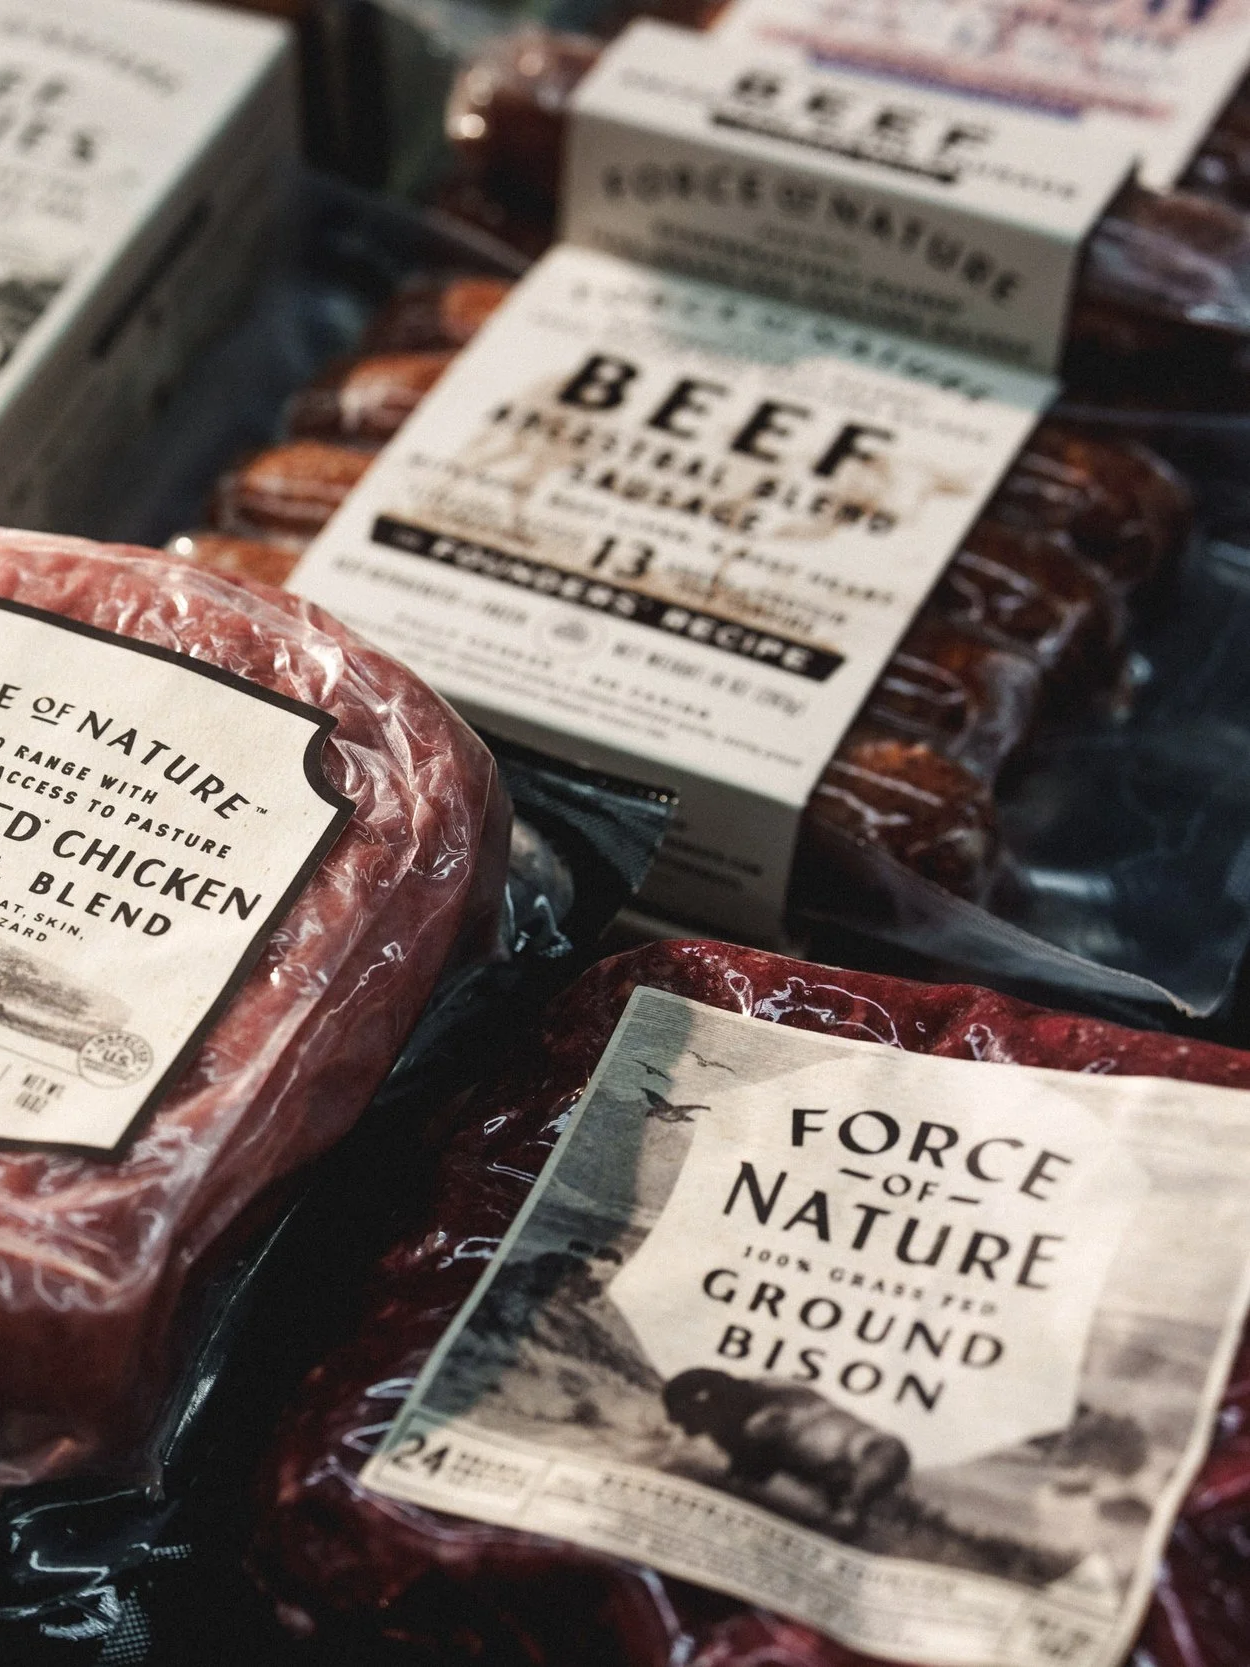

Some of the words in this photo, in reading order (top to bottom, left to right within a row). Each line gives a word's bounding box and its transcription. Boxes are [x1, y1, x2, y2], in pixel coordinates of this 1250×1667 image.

[730, 67, 993, 155] BEEF
[557, 351, 897, 478] BEEF
[590, 533, 655, 580] 13
[661, 605, 813, 673] RECIPE
[31, 696, 76, 722] OF
[14, 745, 91, 780] RANGE
[100, 774, 159, 804] WITH
[88, 799, 116, 818] TO
[124, 812, 232, 859] PASTURE
[28, 871, 172, 936] BLEND
[52, 830, 262, 920] CHICKEN
[34, 912, 84, 941] SKIN,
[791, 1107, 1074, 1201] FORCE
[723, 1160, 1066, 1290] NATURE
[742, 1245, 812, 1273] 100%
[829, 1267, 926, 1300] GRASS
[702, 1267, 1006, 1370] GROUND
[717, 1323, 946, 1412] BISON
[390, 1432, 451, 1478] 24
